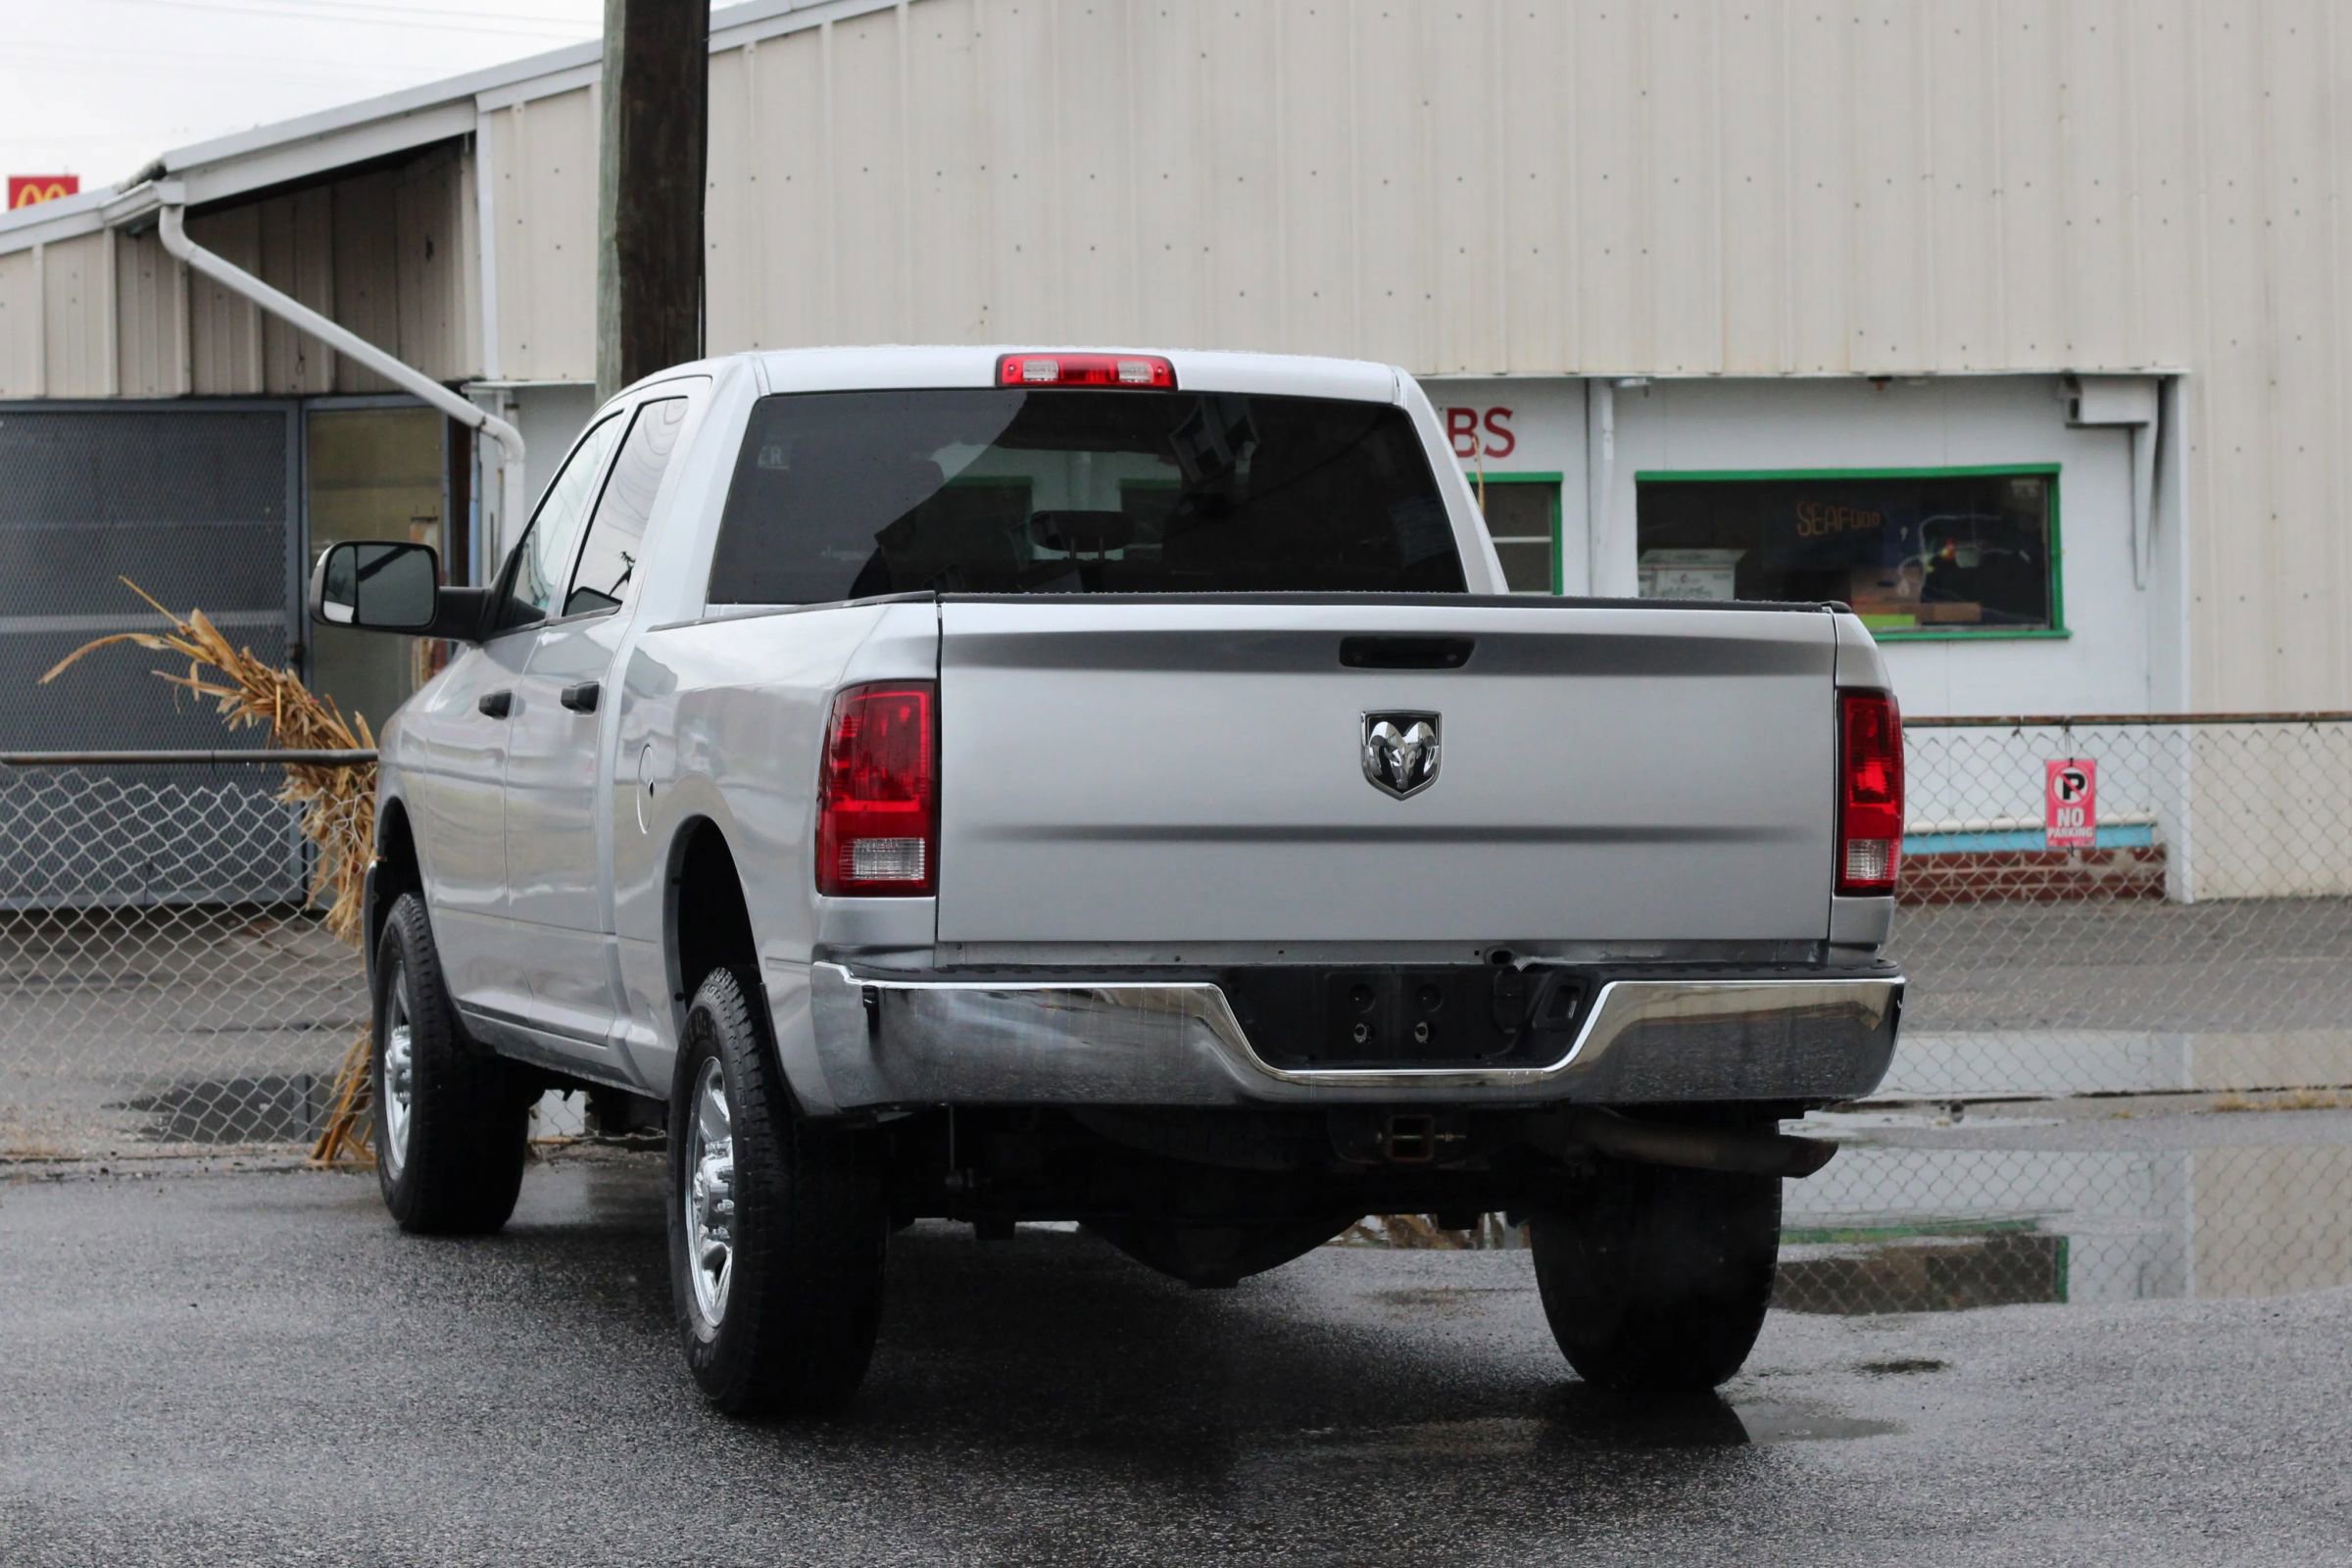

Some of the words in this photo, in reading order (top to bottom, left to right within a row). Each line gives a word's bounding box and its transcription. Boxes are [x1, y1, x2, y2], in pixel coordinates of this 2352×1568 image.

[1795, 501, 1881, 536] SEAFOOD
[2063, 772, 2085, 800] P
[2057, 808, 2084, 827] NO
[2047, 827, 2093, 839] PARKING
